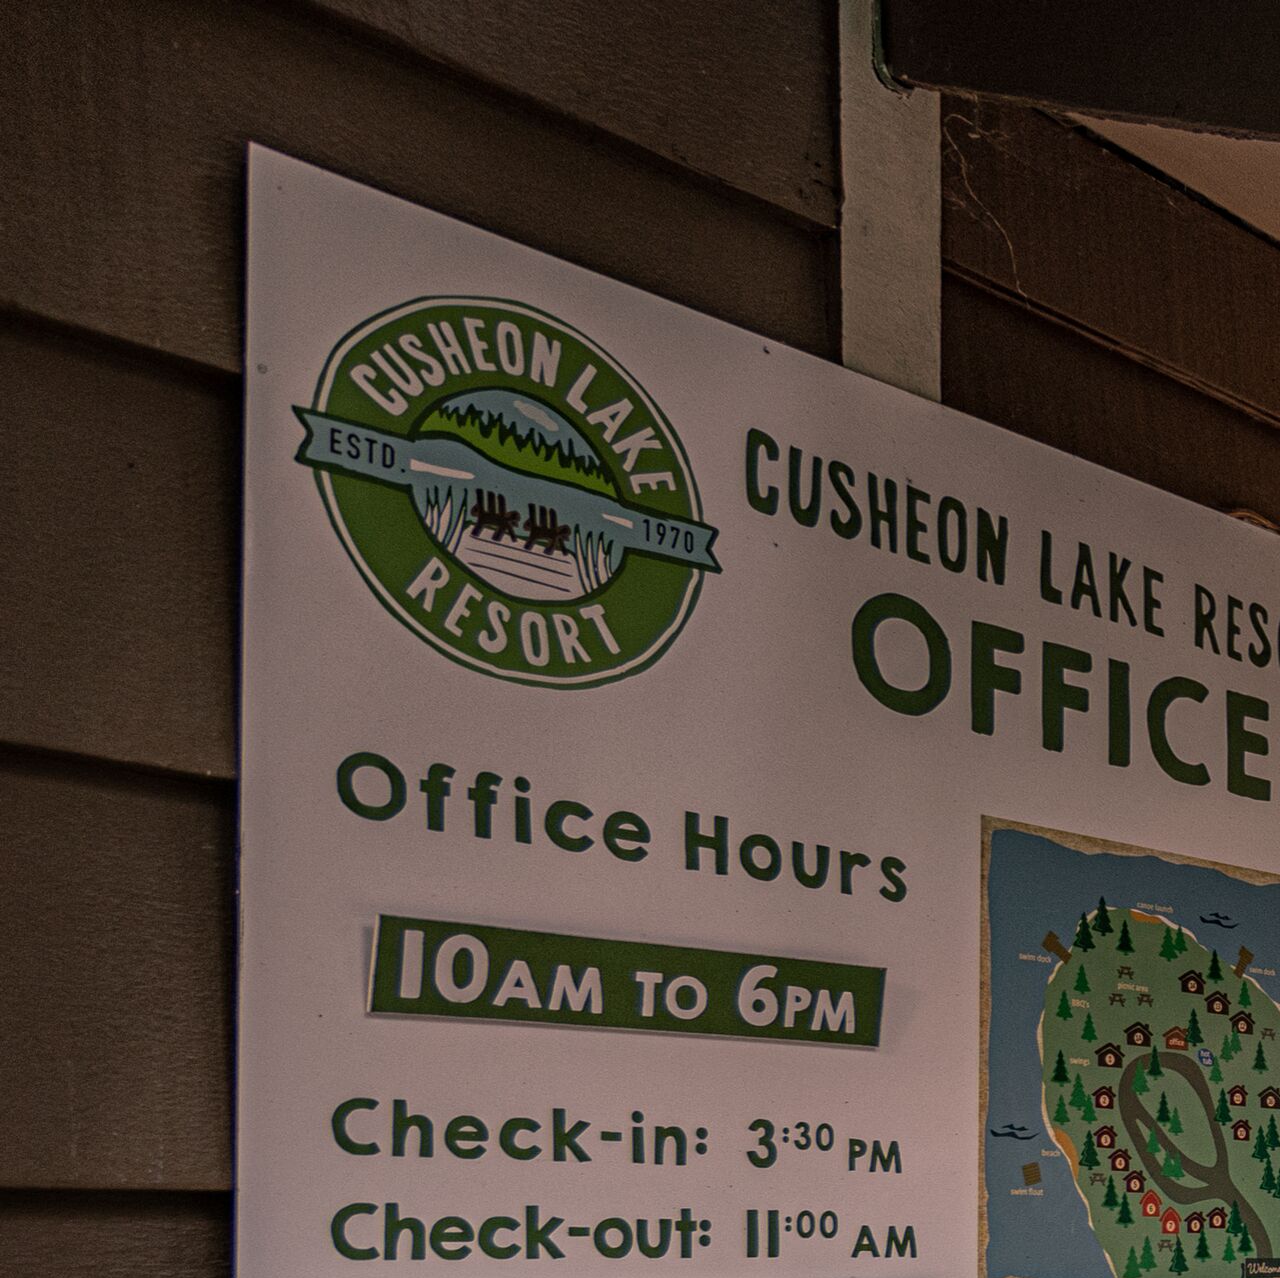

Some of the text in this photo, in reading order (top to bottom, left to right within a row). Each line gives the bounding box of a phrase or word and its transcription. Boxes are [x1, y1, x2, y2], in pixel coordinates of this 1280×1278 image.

[329, 428, 406, 473] ESTD.
[350, 317, 676, 494] CUSHEON LAKE
[642, 519, 694, 554] 1970
[746, 427, 1008, 586] CUSHEON
[1040, 530, 1165, 637] LAKE
[406, 557, 621, 666] RESORT
[852, 591, 1271, 801] OFFICE
[336, 751, 909, 902] Office Hours
[400, 929, 856, 1034] 10AM TO 6PM
[331, 1097, 902, 1174] Check-in: 3:30 PM
[330, 1202, 917, 1261] Check-out: 11:00 AM
